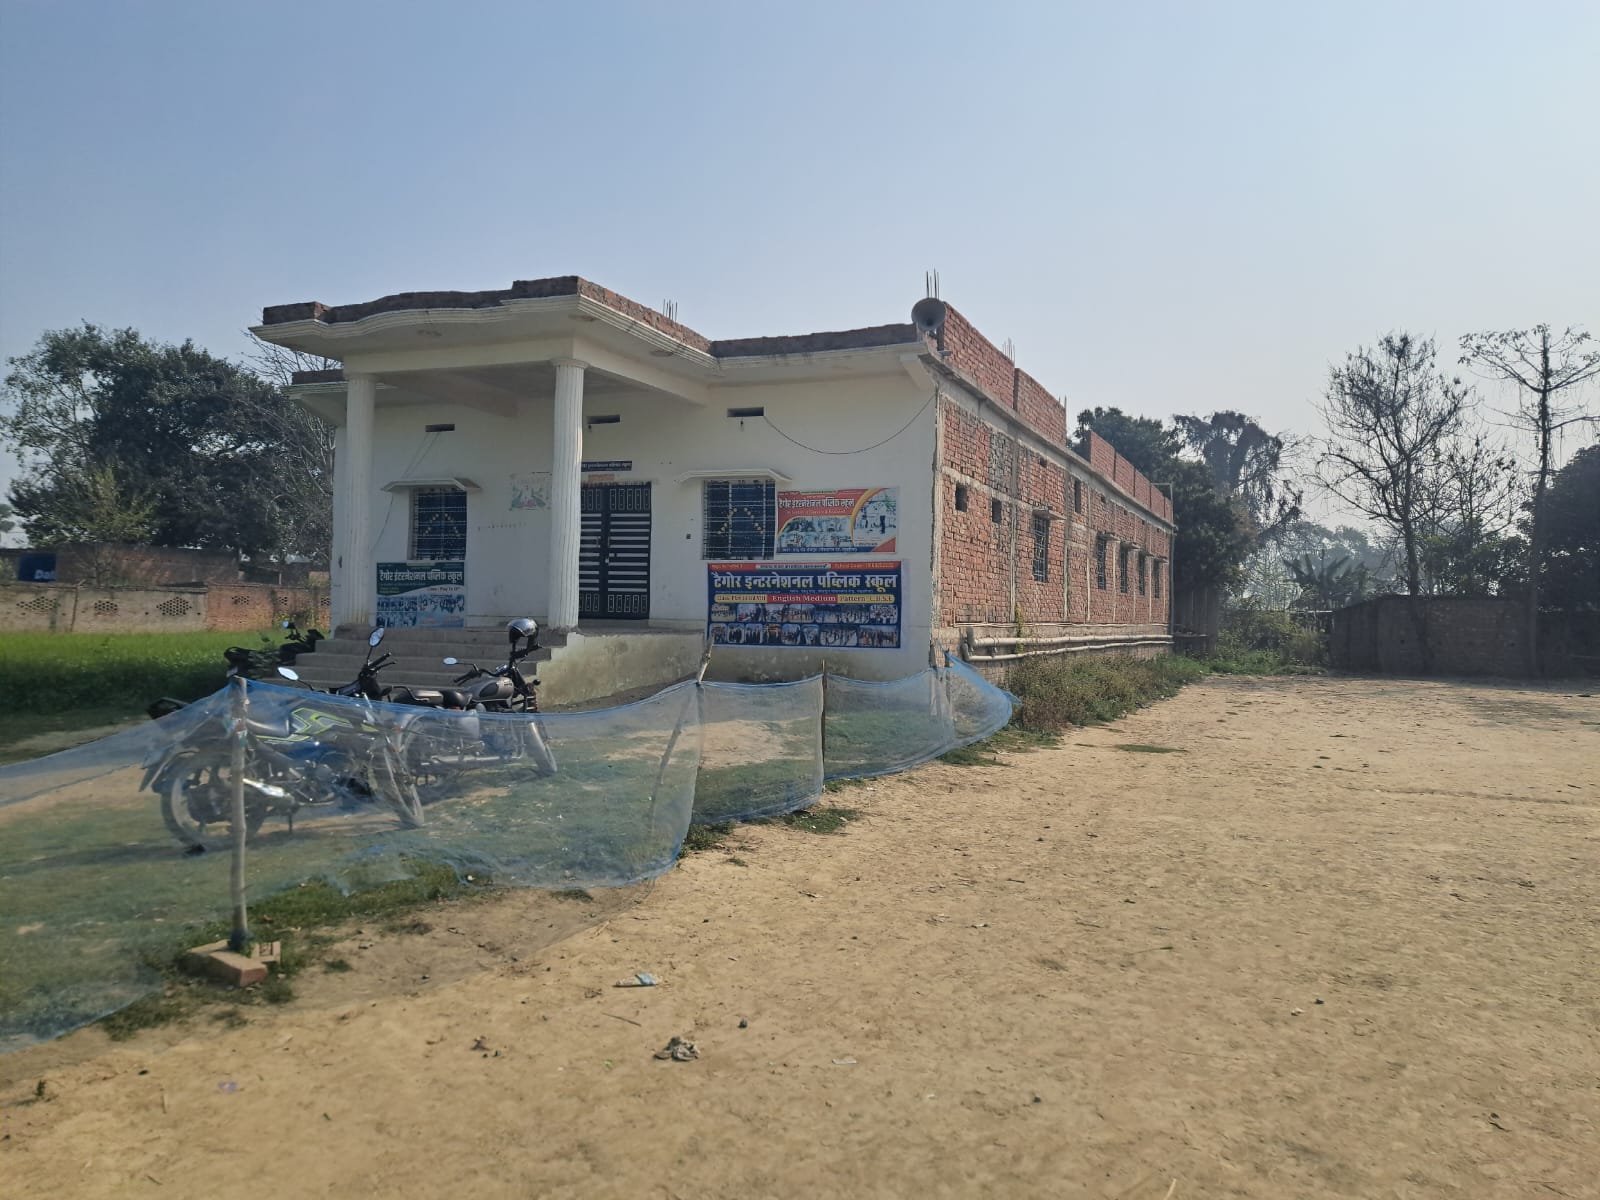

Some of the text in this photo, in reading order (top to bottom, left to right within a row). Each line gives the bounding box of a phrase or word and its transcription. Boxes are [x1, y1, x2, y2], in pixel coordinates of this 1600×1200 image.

[711, 571, 898, 593] टैगोर इन्टरनेशनल पब्लिक स्कूल
[772, 595, 801, 603] English
